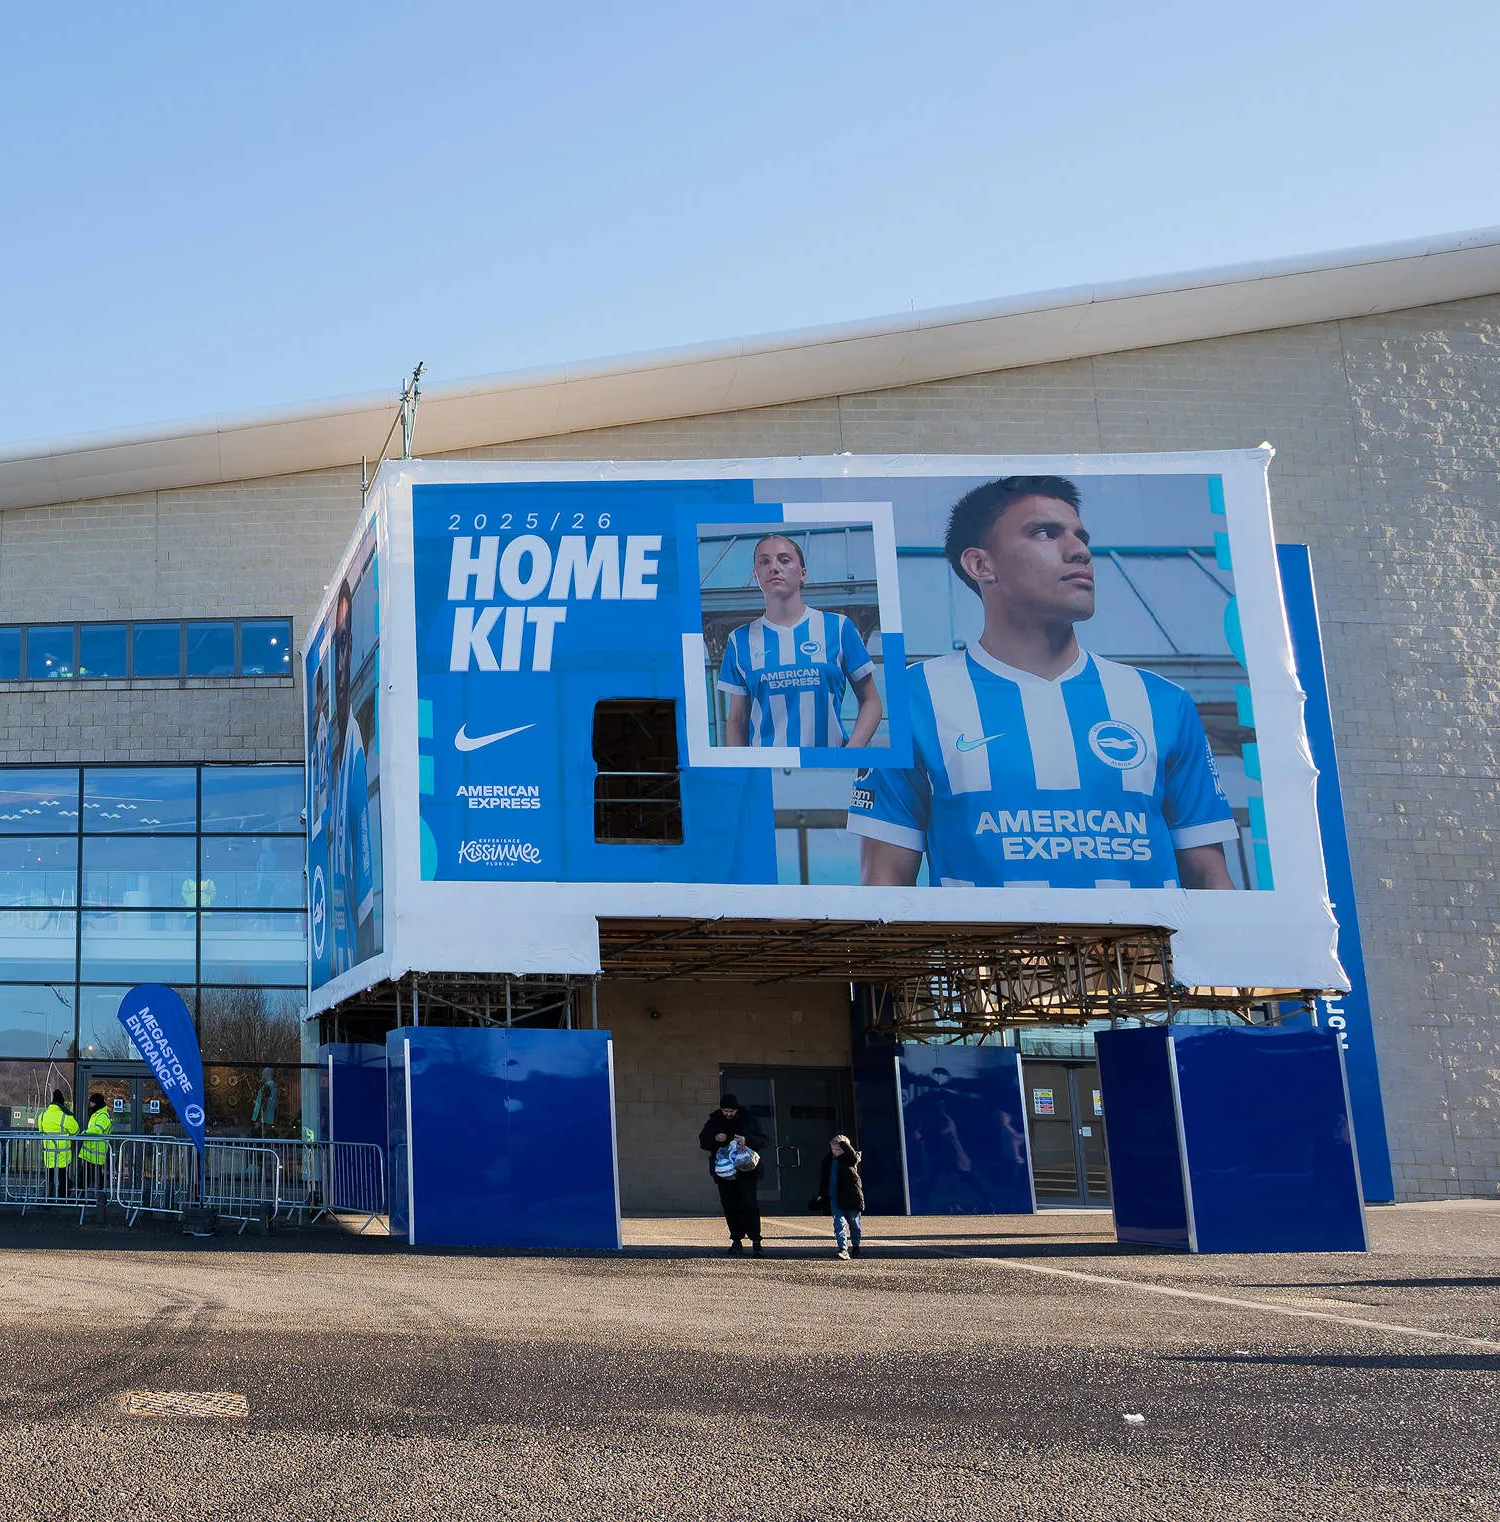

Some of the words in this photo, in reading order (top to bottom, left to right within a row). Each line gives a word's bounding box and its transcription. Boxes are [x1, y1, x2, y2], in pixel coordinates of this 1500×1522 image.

[448, 512, 612, 531] 2025/26
[447, 534, 662, 601] HOME
[450, 606, 567, 672] KIT
[760, 667, 820, 682] AMERICAN
[769, 676, 820, 690] EXPRESS
[456, 785, 539, 797] AMERICAN
[468, 798, 541, 809] EXPRESS
[975, 809, 1148, 835] AMERICAN
[1002, 836, 1152, 861] EXPRESS
[125, 1014, 177, 1090] ENTRANCE
[138, 1006, 193, 1094] MEGASTORE
